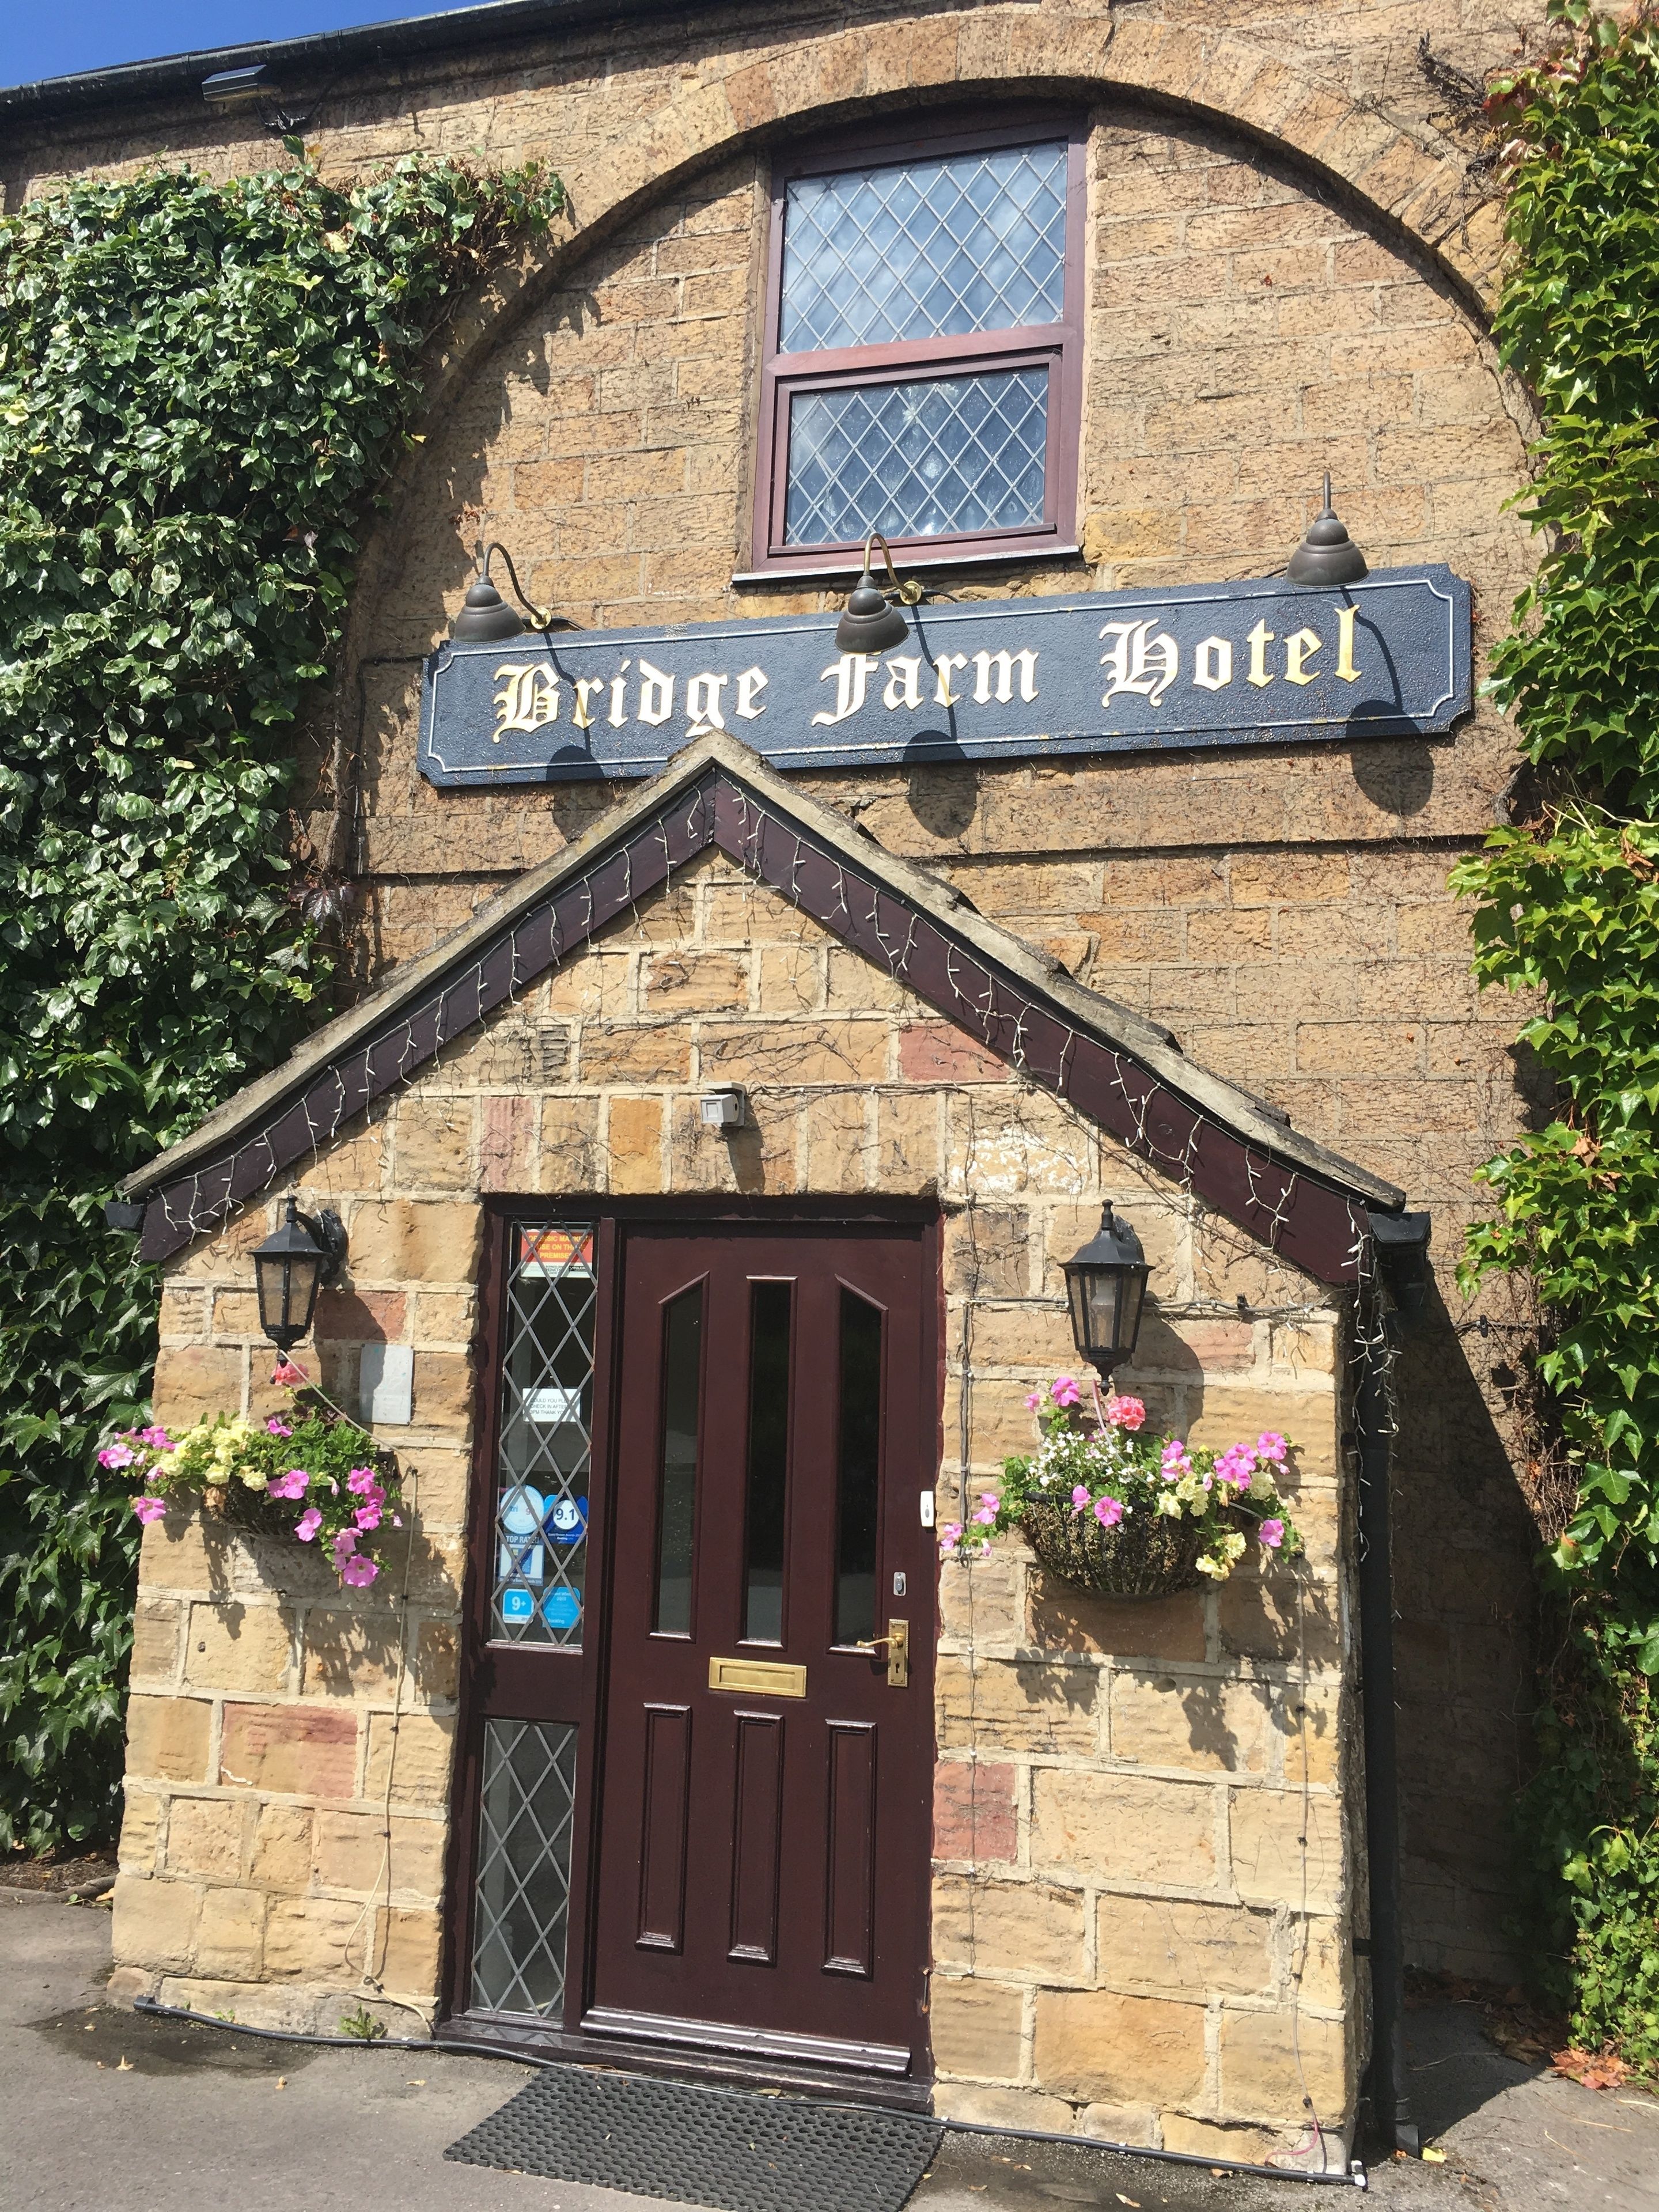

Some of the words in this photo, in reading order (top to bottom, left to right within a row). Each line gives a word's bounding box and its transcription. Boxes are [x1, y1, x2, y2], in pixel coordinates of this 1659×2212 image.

[493, 658, 769, 744] Bridge
[811, 648, 1040, 727] Farm
[1099, 604, 1361, 708] Hotel
[556, 1508, 575, 1521] 9.1
